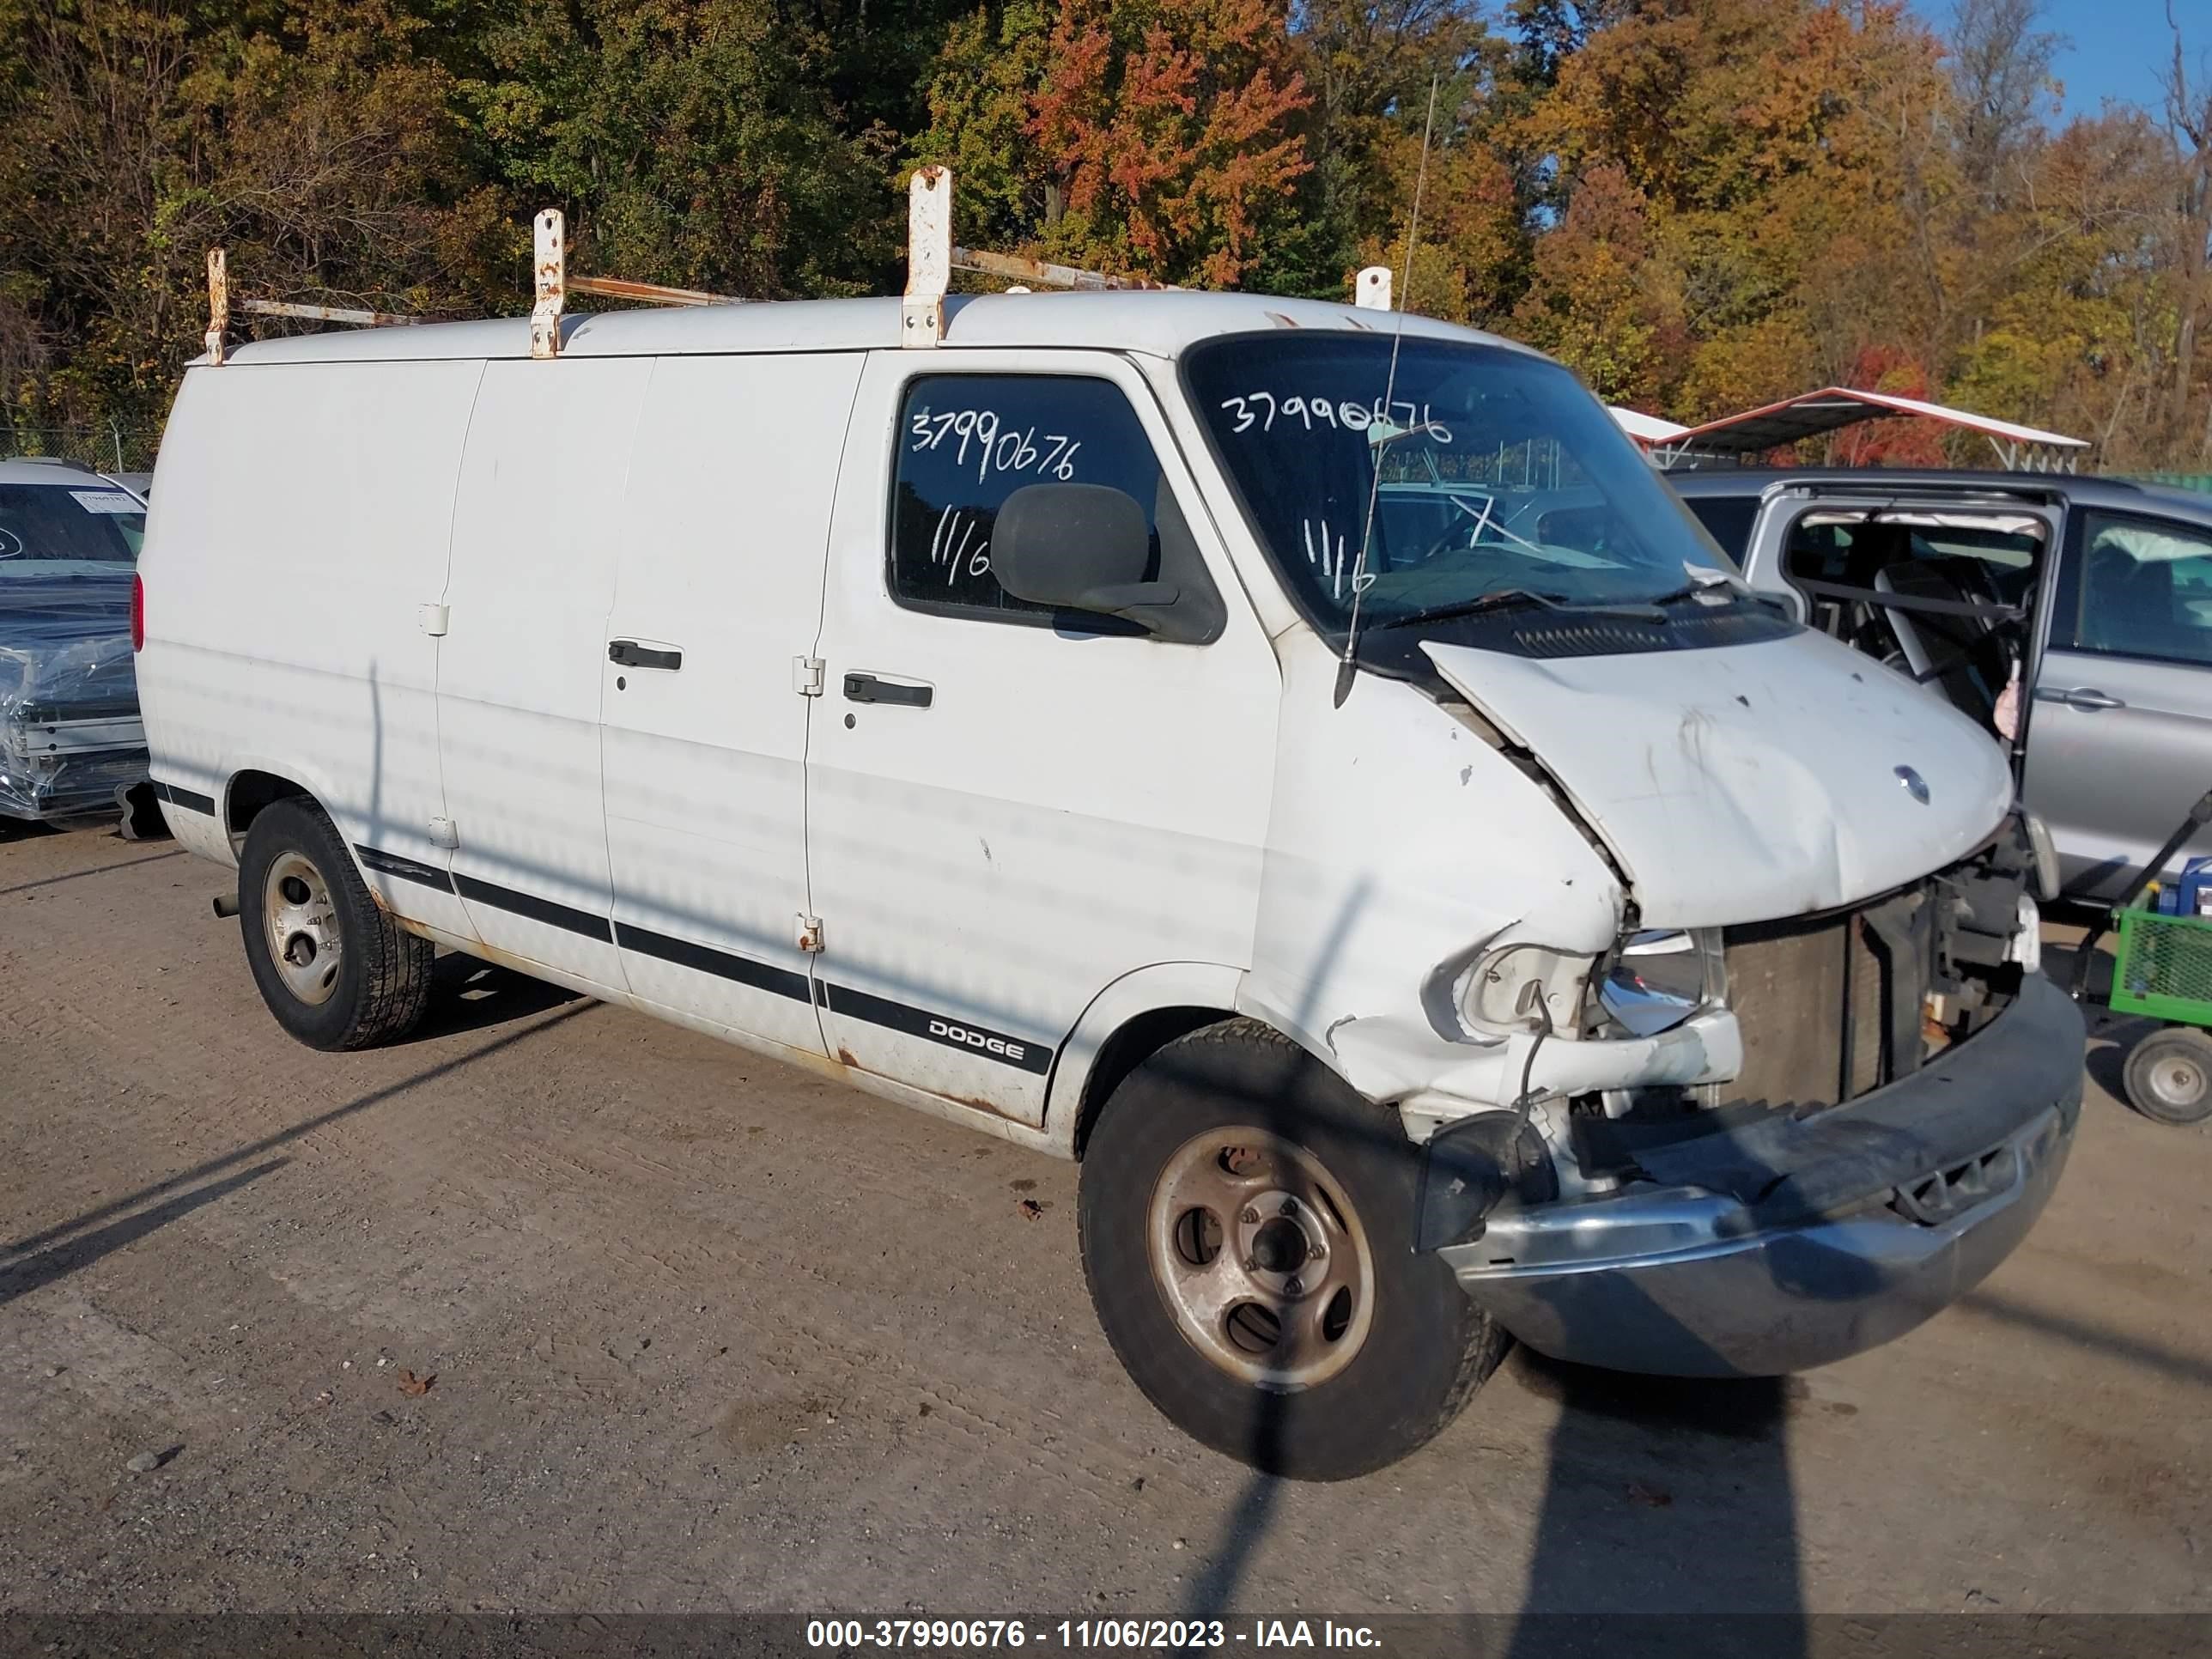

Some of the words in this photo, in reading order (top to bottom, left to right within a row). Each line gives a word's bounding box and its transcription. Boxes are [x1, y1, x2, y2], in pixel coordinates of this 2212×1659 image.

[912, 406, 1082, 485] 37990676
[931, 503, 992, 586] 11/6
[928, 1019, 1025, 1060] DODGE
